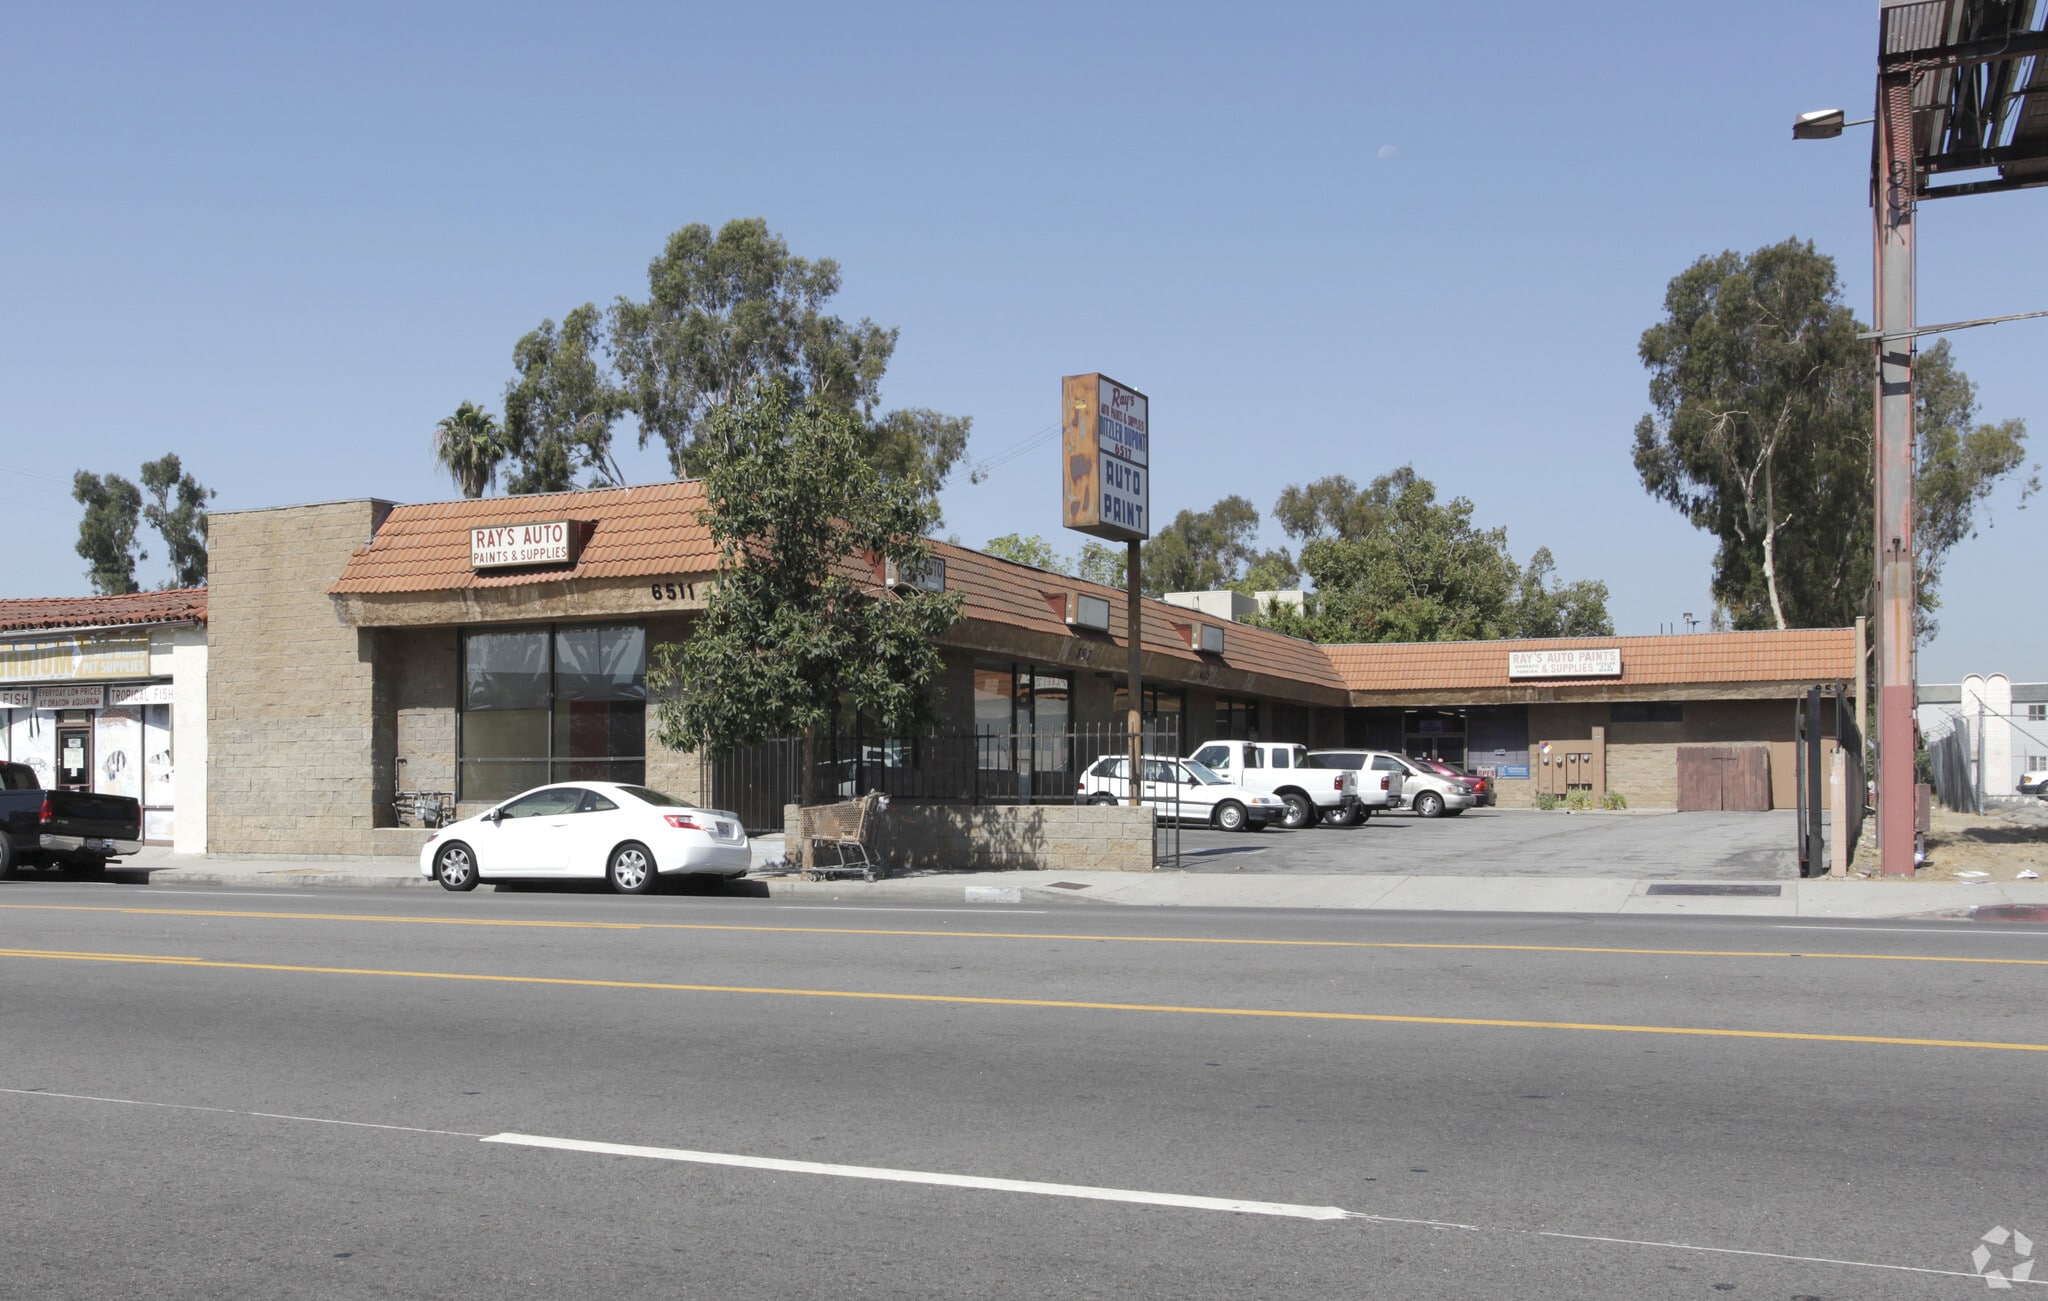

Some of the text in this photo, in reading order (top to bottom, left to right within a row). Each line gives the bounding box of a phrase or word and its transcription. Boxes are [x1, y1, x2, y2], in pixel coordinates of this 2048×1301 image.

[1112, 387, 1135, 412] Ray's
[1128, 415, 1144, 432] SUPPLIES
[1124, 426, 1146, 453] DUPONT
[1115, 443, 1132, 460] 6517
[1106, 460, 1140, 495] AUTO
[1104, 493, 1143, 529] PAINT
[477, 524, 563, 548] RAY'S AUTO
[474, 546, 567, 564] PAINTS & SUPPLIES
[652, 582, 694, 601] 6511
[1513, 651, 1617, 664] RAY'S AUTO PAINTS
[82, 660, 145, 673] PET SUPPLIES
[1541, 664, 1548, 673] &
[1551, 663, 1594, 673] SUPPLIES
[3, 692, 29, 705] FISH
[39, 686, 102, 697] EVERYDAY LOW PRICES
[112, 688, 174, 702] TROPICAL FISH
[40, 699, 47, 707] AT
